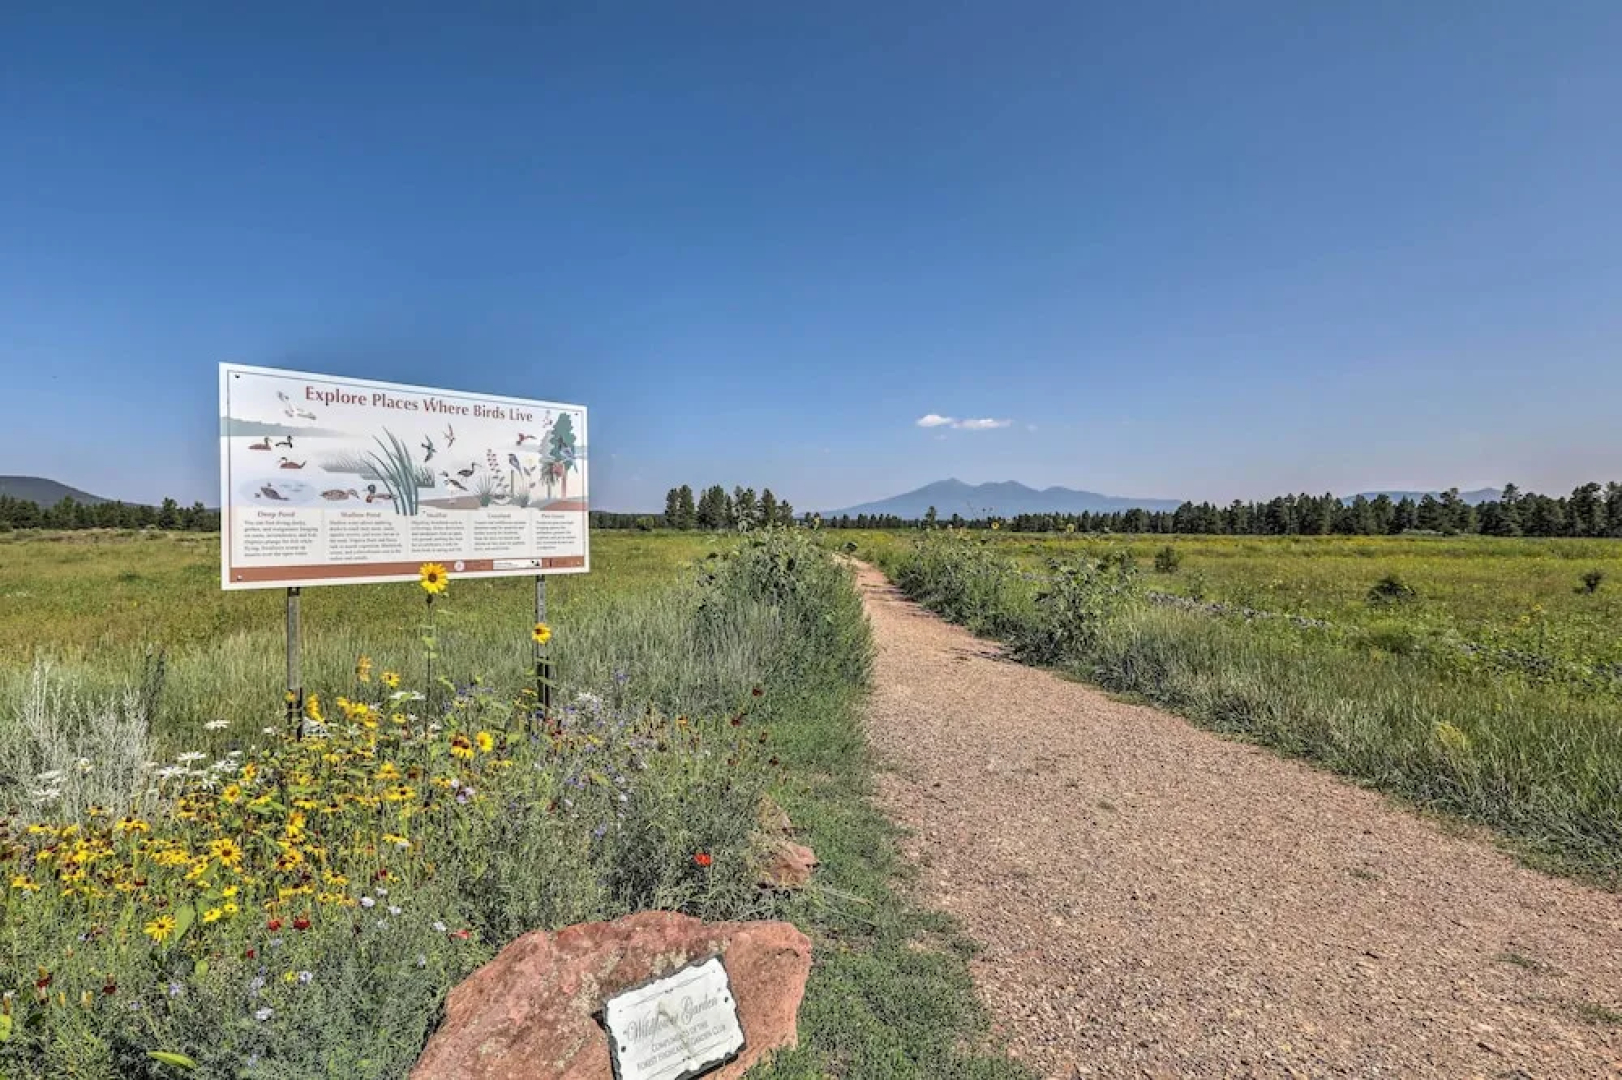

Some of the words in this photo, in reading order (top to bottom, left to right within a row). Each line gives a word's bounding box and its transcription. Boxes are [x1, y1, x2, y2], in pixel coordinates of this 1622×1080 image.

[305, 385, 367, 406] Explore
[372, 393, 418, 411] Places
[423, 397, 469, 415] Where
[473, 404, 505, 419] Birds
[509, 408, 533, 422] Live
[257, 511, 277, 519] Deep
[681, 993, 718, 1025] Garden
